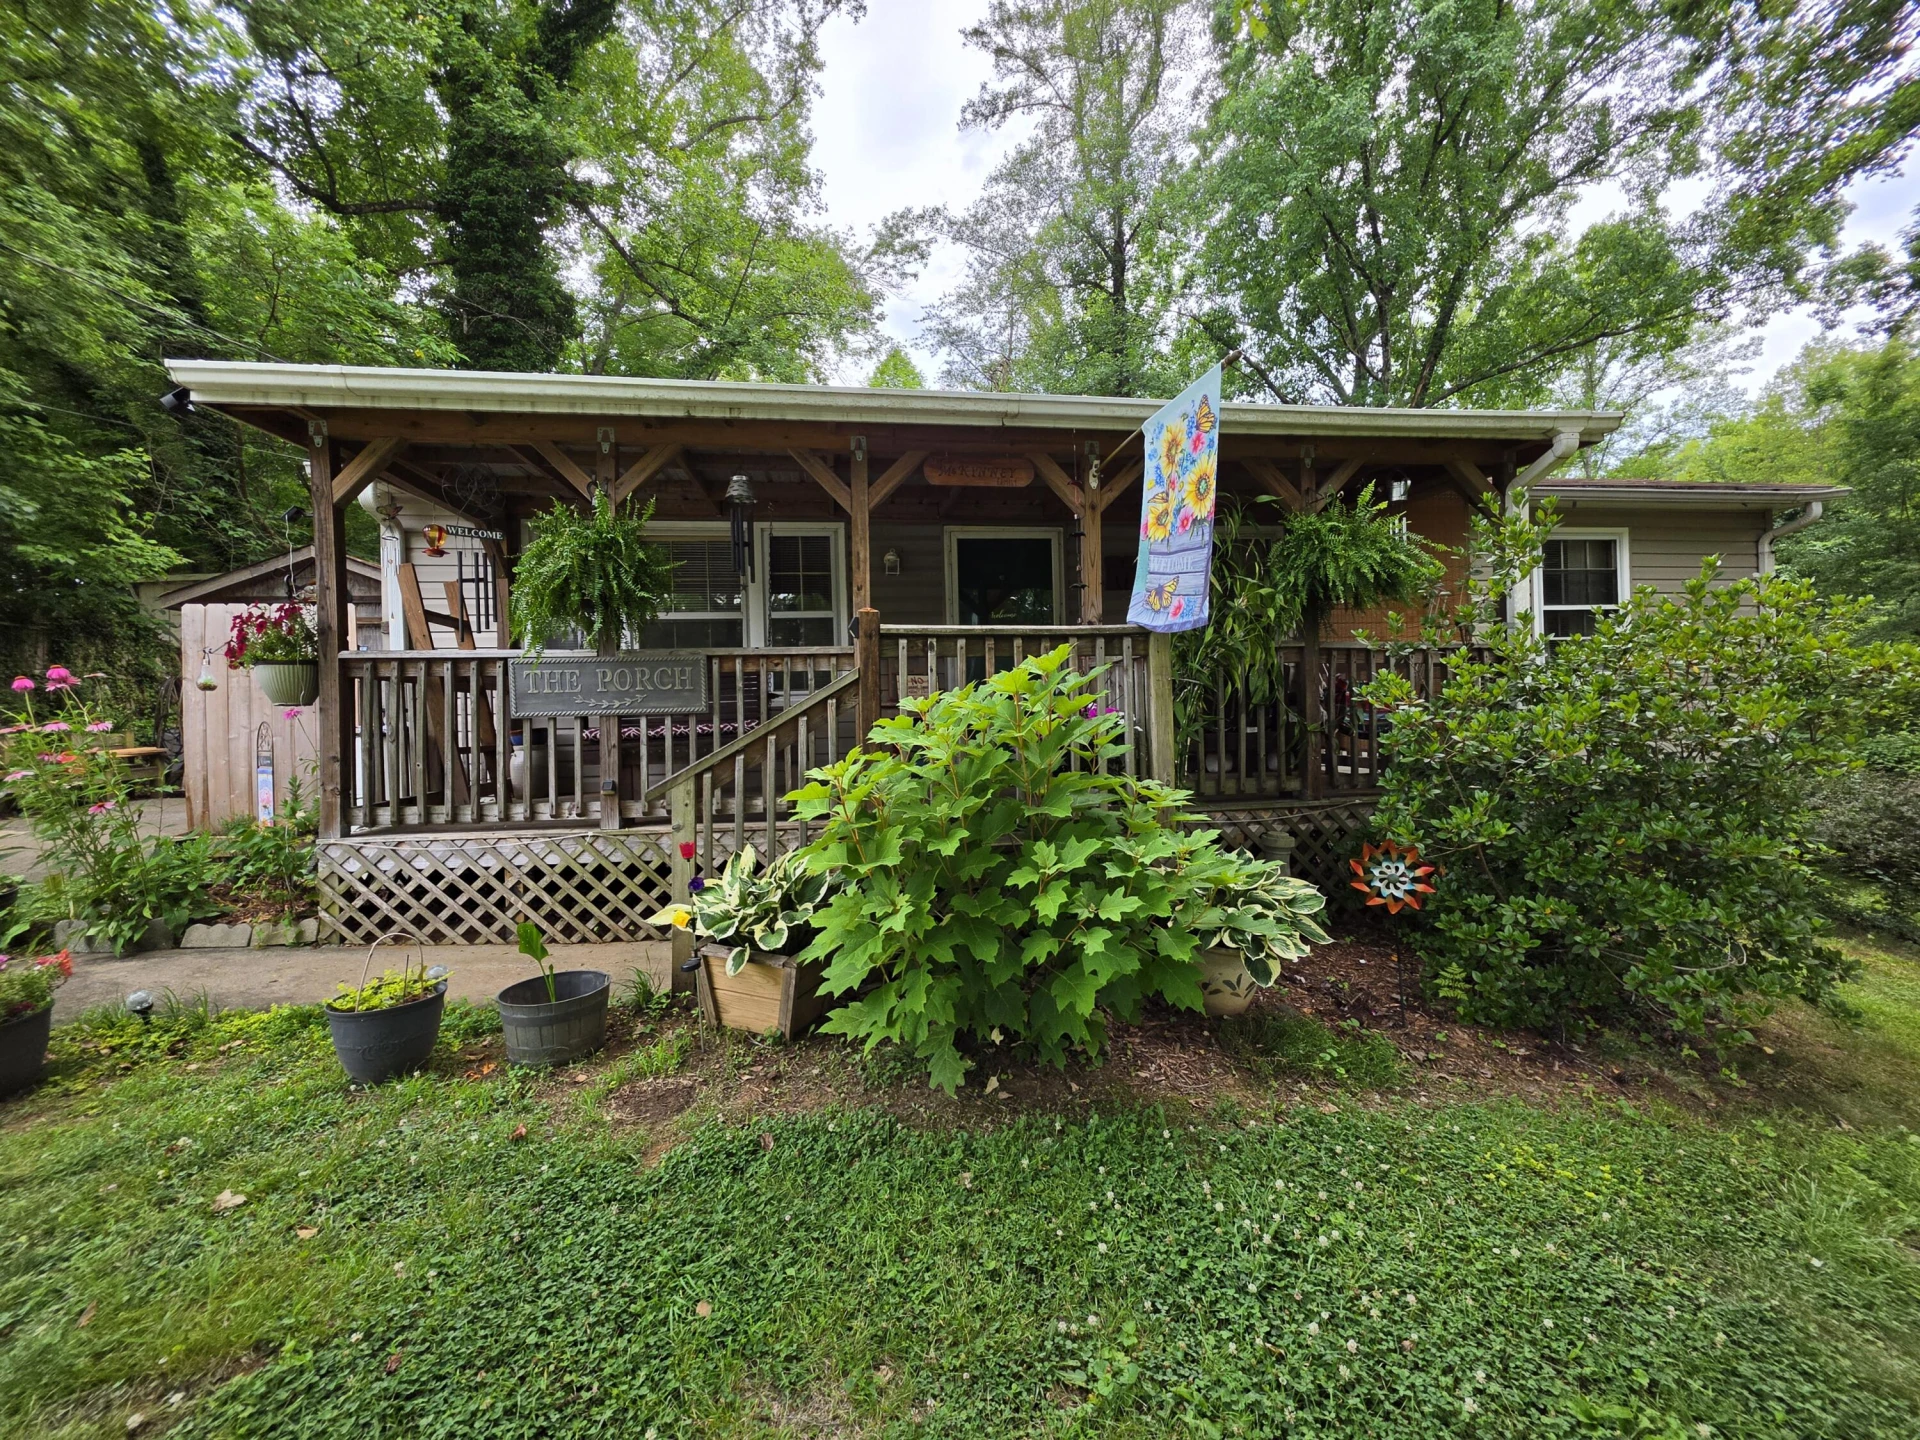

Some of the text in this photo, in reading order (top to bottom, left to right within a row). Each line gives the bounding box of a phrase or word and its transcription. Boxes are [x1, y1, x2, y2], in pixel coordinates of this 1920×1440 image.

[447, 525, 503, 540] WELCOME
[523, 667, 694, 694] THE PORCH
[910, 676, 925, 686] NO
